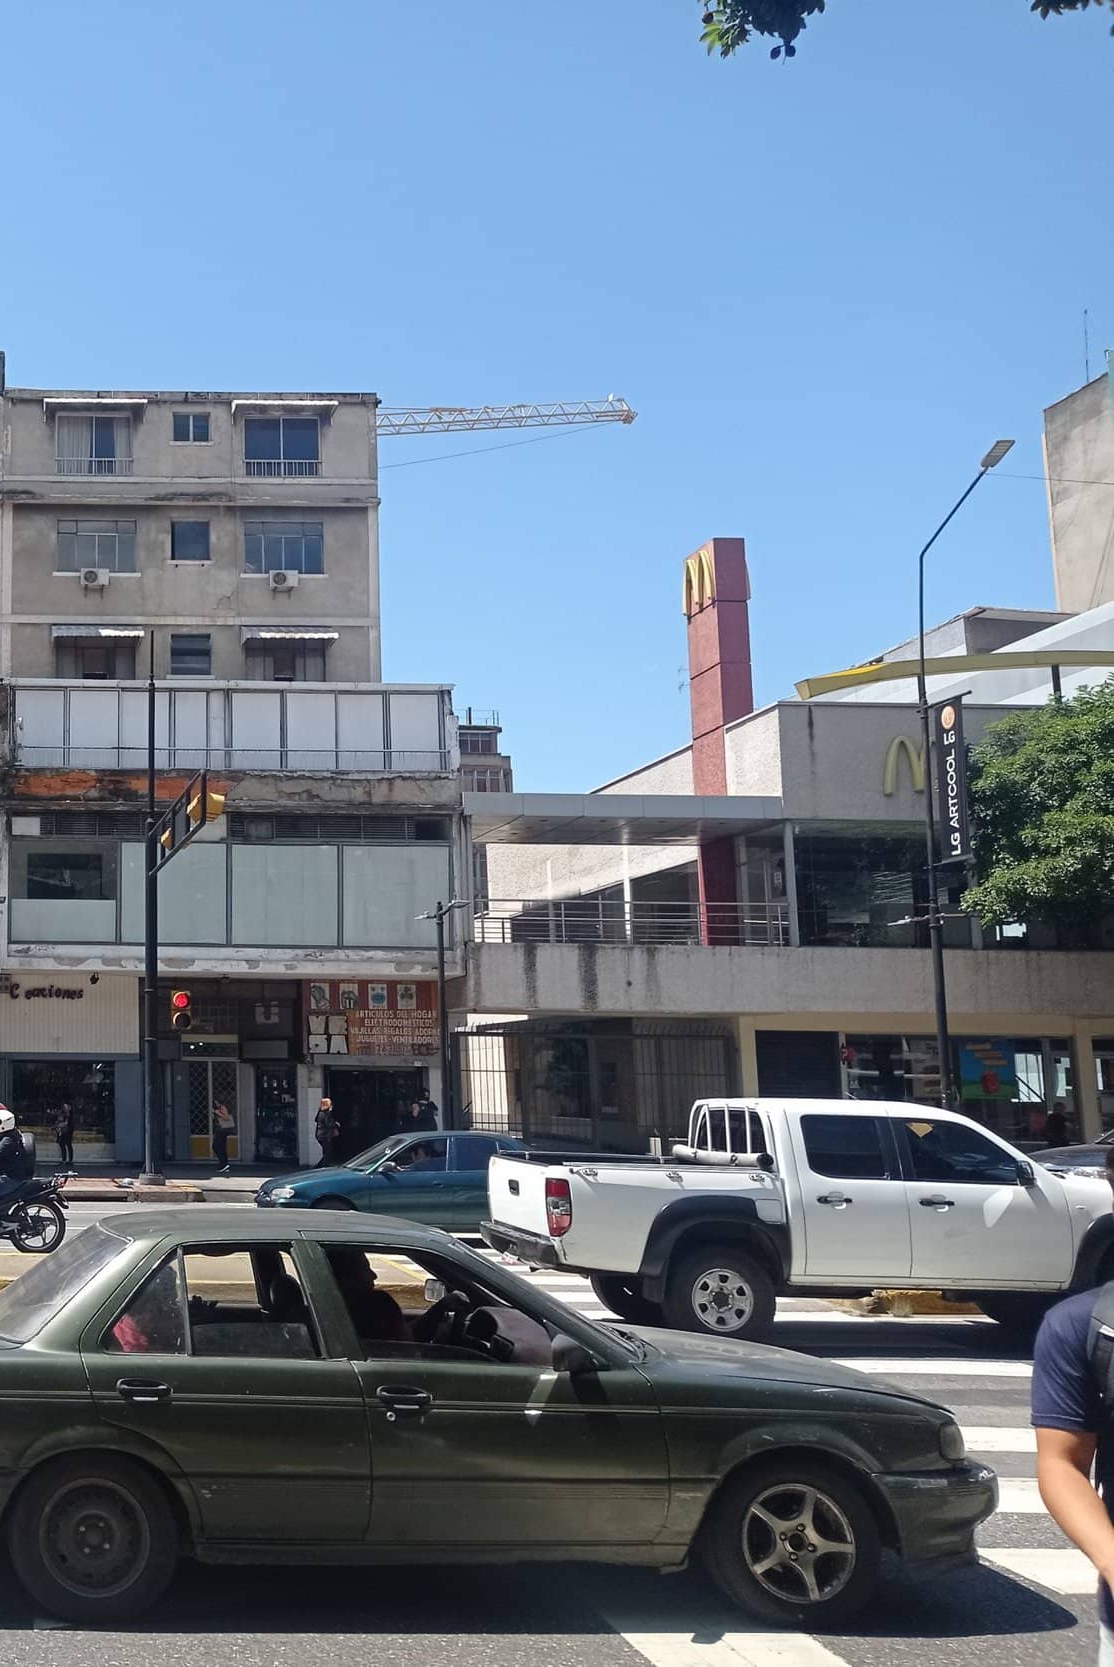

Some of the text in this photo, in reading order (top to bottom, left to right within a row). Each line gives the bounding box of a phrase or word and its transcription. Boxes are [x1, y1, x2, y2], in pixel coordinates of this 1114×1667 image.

[943, 730, 956, 745] LG
[945, 748, 962, 856] LG ARTCOOL
[396, 1010, 409, 1019] DEL
